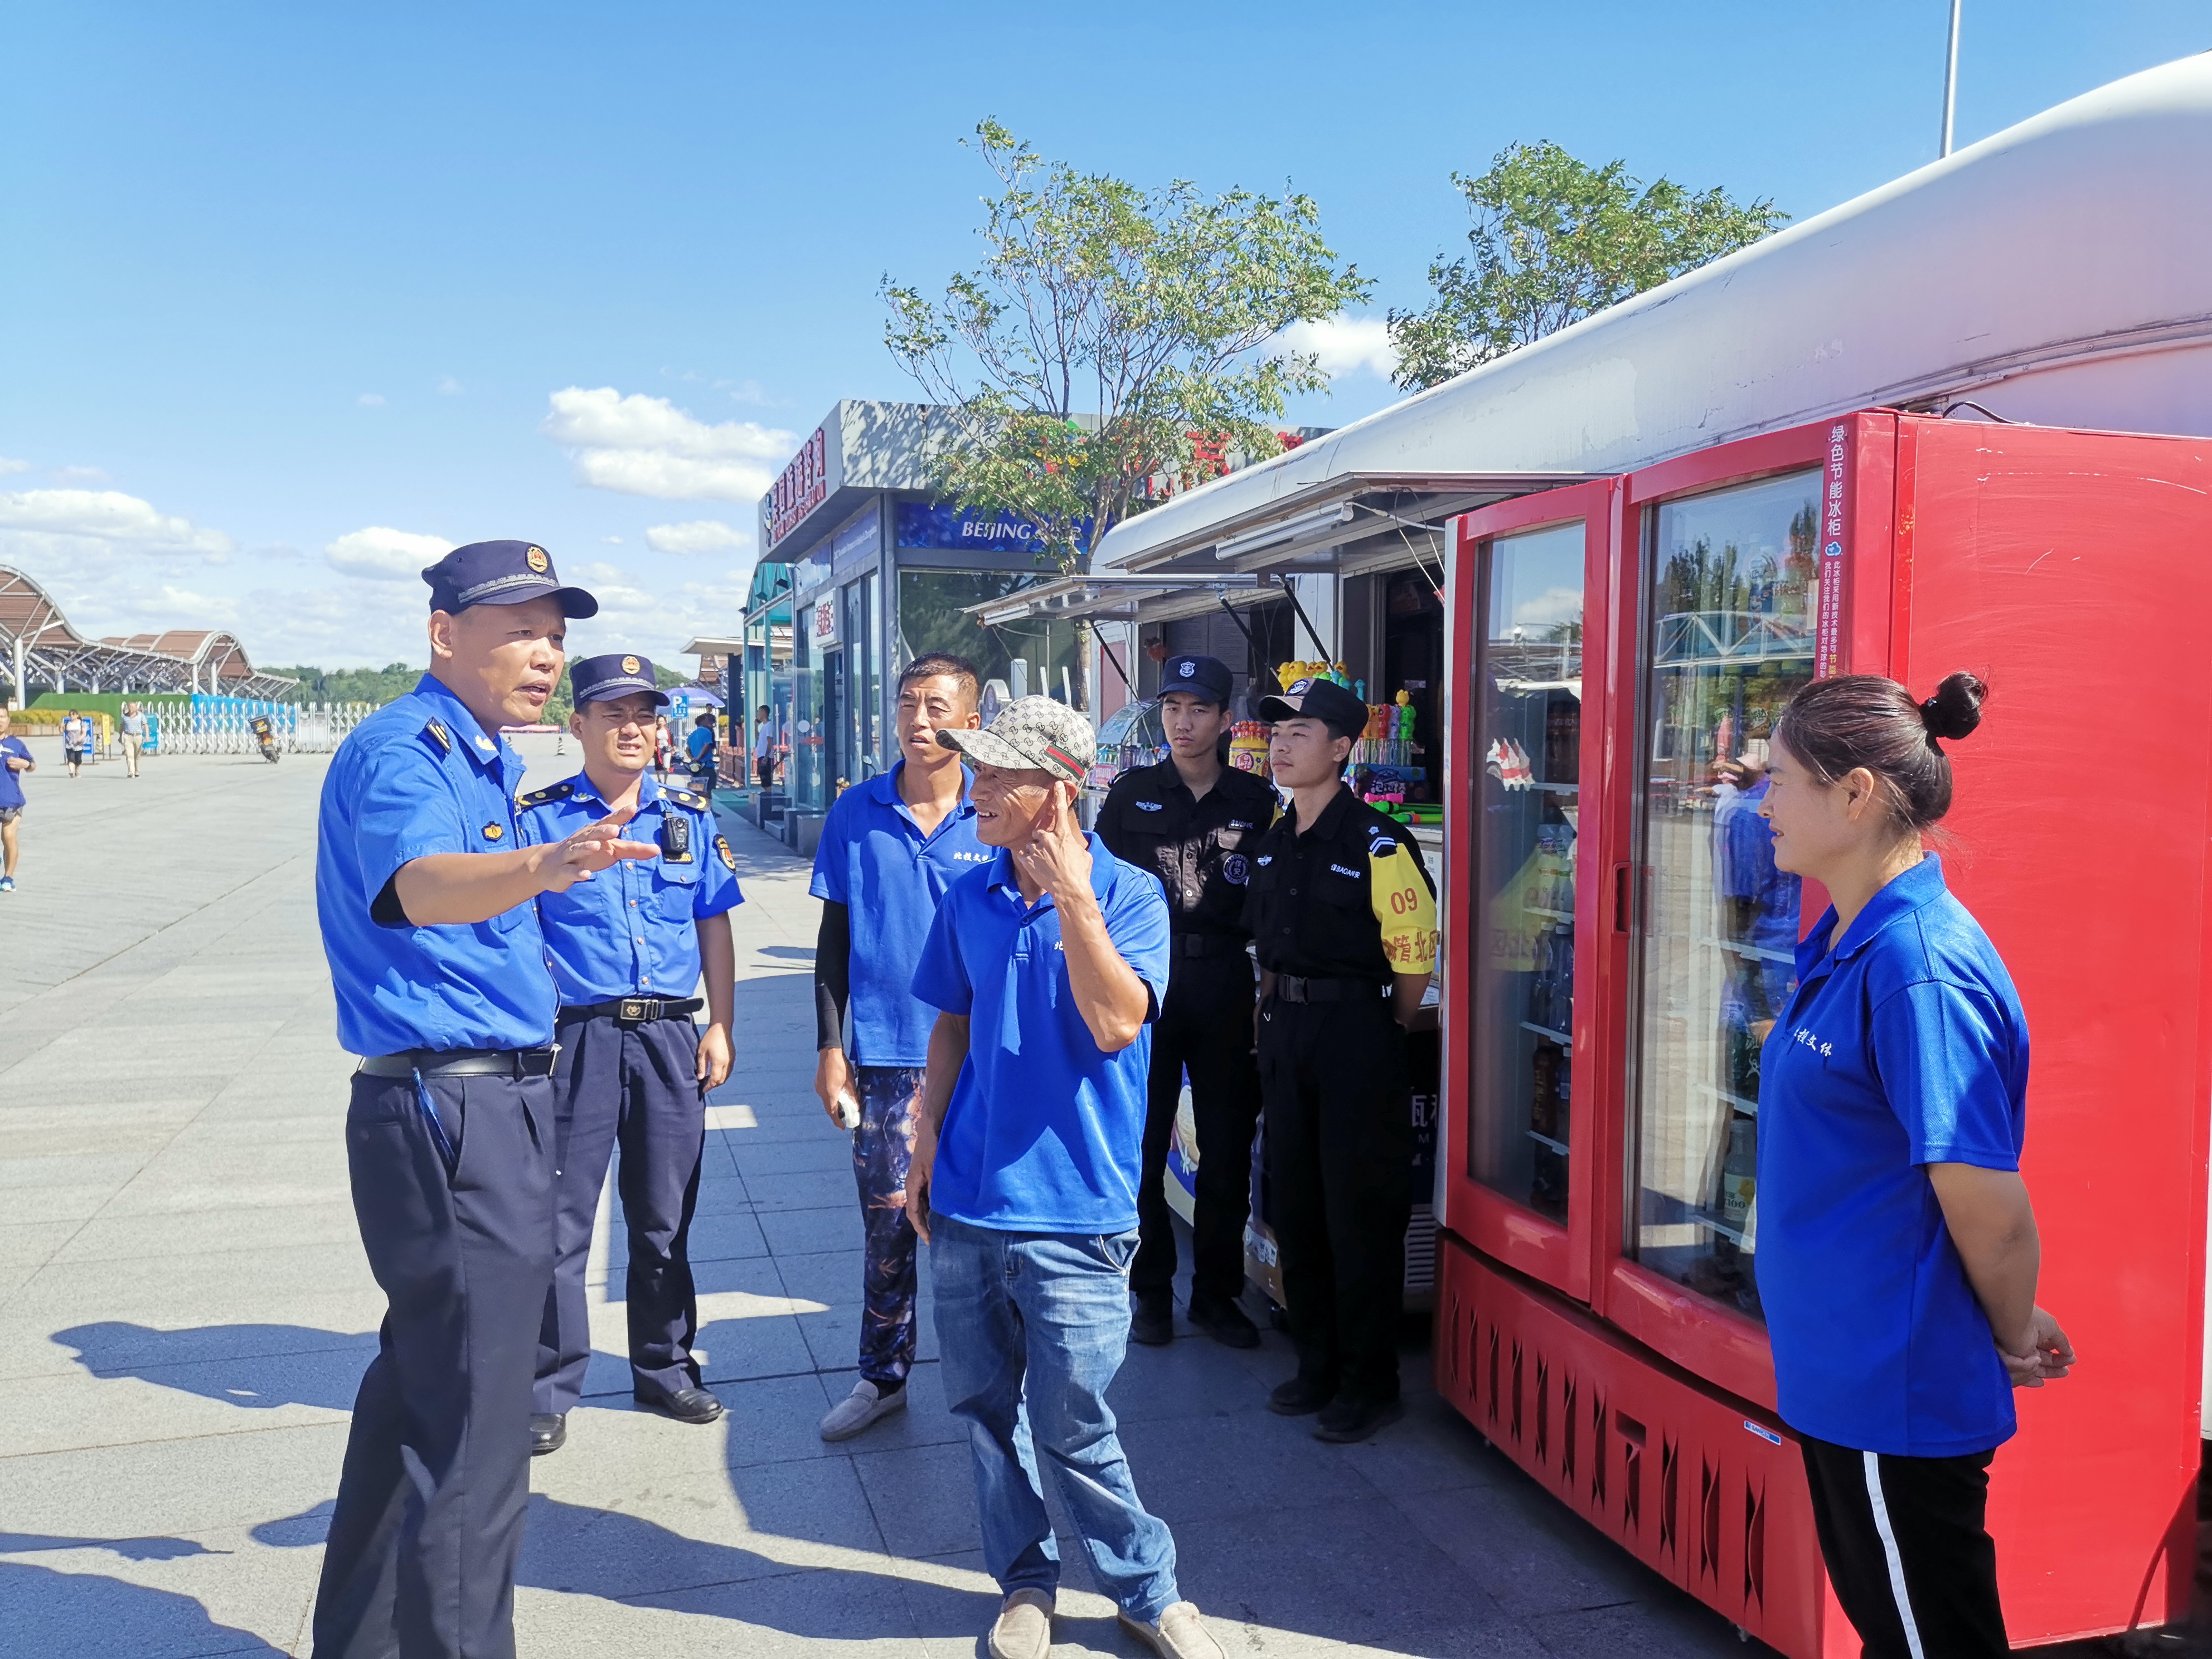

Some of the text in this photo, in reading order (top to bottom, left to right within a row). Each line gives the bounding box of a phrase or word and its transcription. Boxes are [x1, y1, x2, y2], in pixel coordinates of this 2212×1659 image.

[1827, 425, 1845, 536] 绿色节能冰柜
[962, 521, 1031, 541] BEIJING
[1828, 561, 1841, 679] 此冰柜采用新技术最多可节能
[673, 696, 682, 709] P
[1390, 887, 1418, 915] 09
[1382, 929, 1437, 963] 管北区
